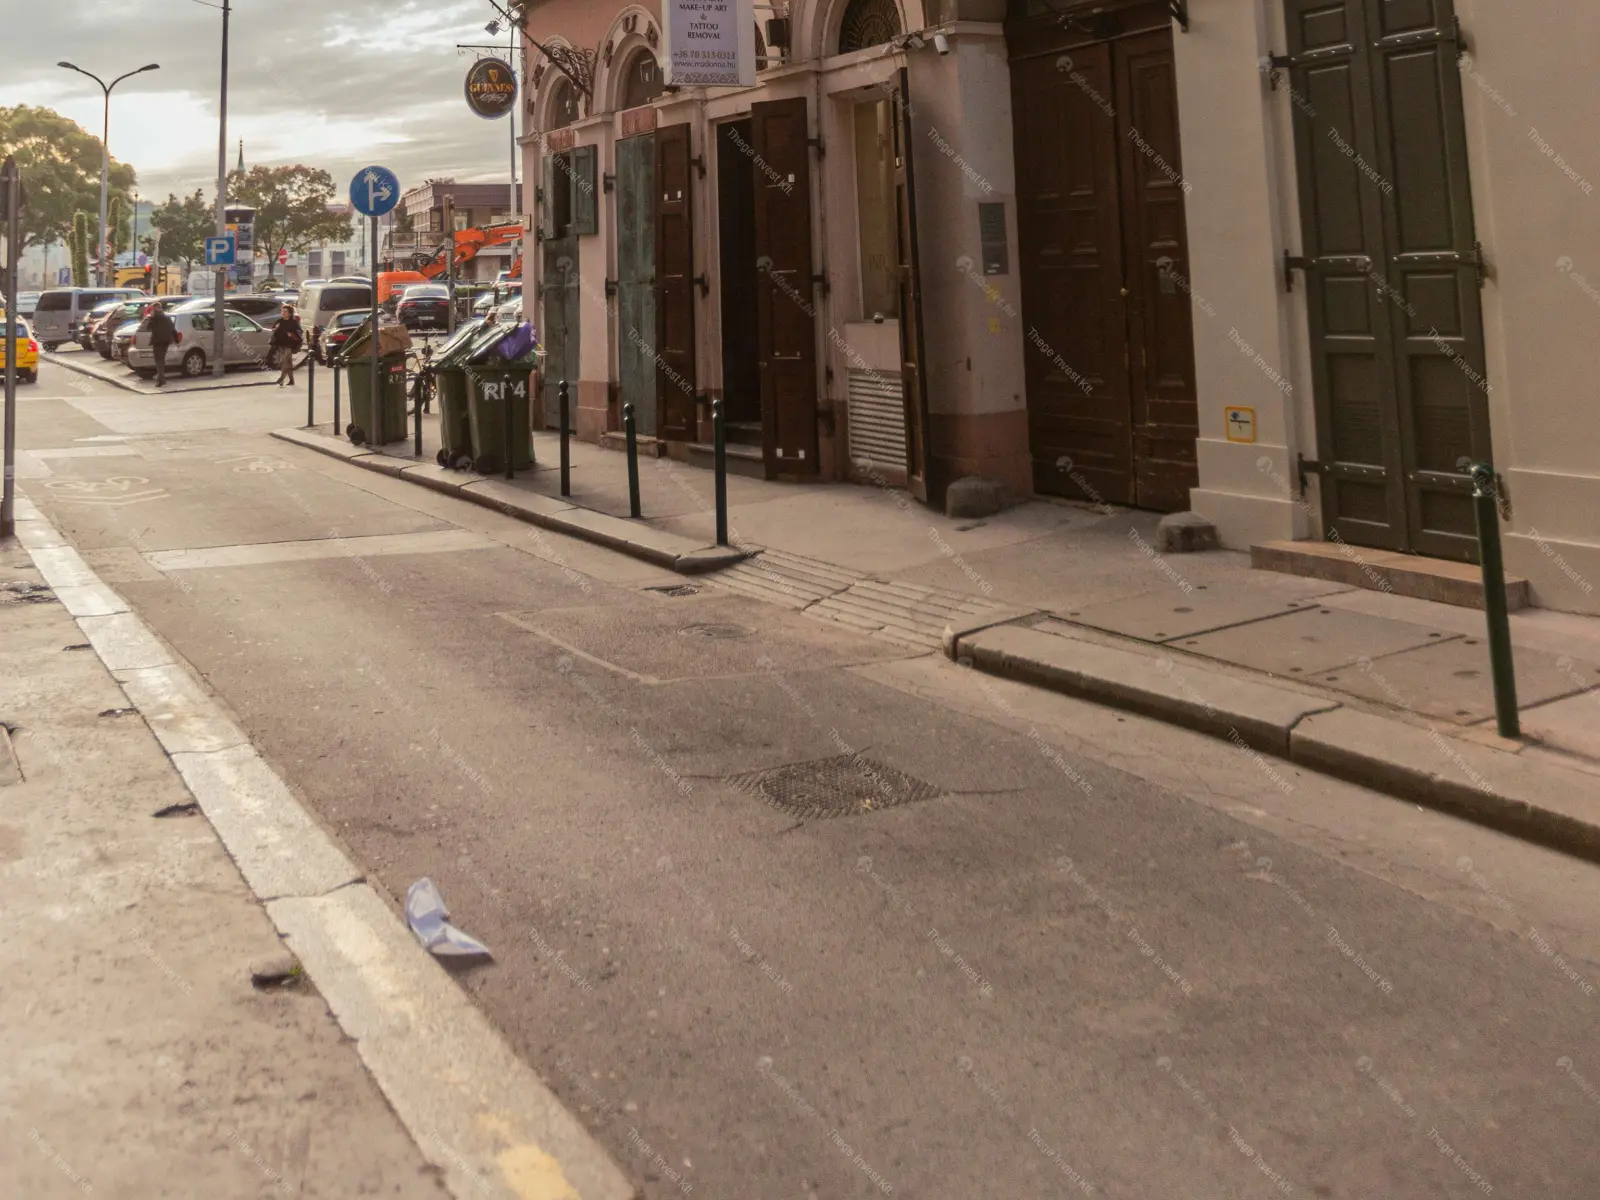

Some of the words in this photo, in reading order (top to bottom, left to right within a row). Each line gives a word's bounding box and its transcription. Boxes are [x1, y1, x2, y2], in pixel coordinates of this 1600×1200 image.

[679, 4, 713, 12] MAKE-UP
[690, 22, 719, 31] TATTOO
[687, 31, 722, 40] REMOVAL
[470, 83, 515, 93] GUINNESS
[211, 240, 230, 263] P
